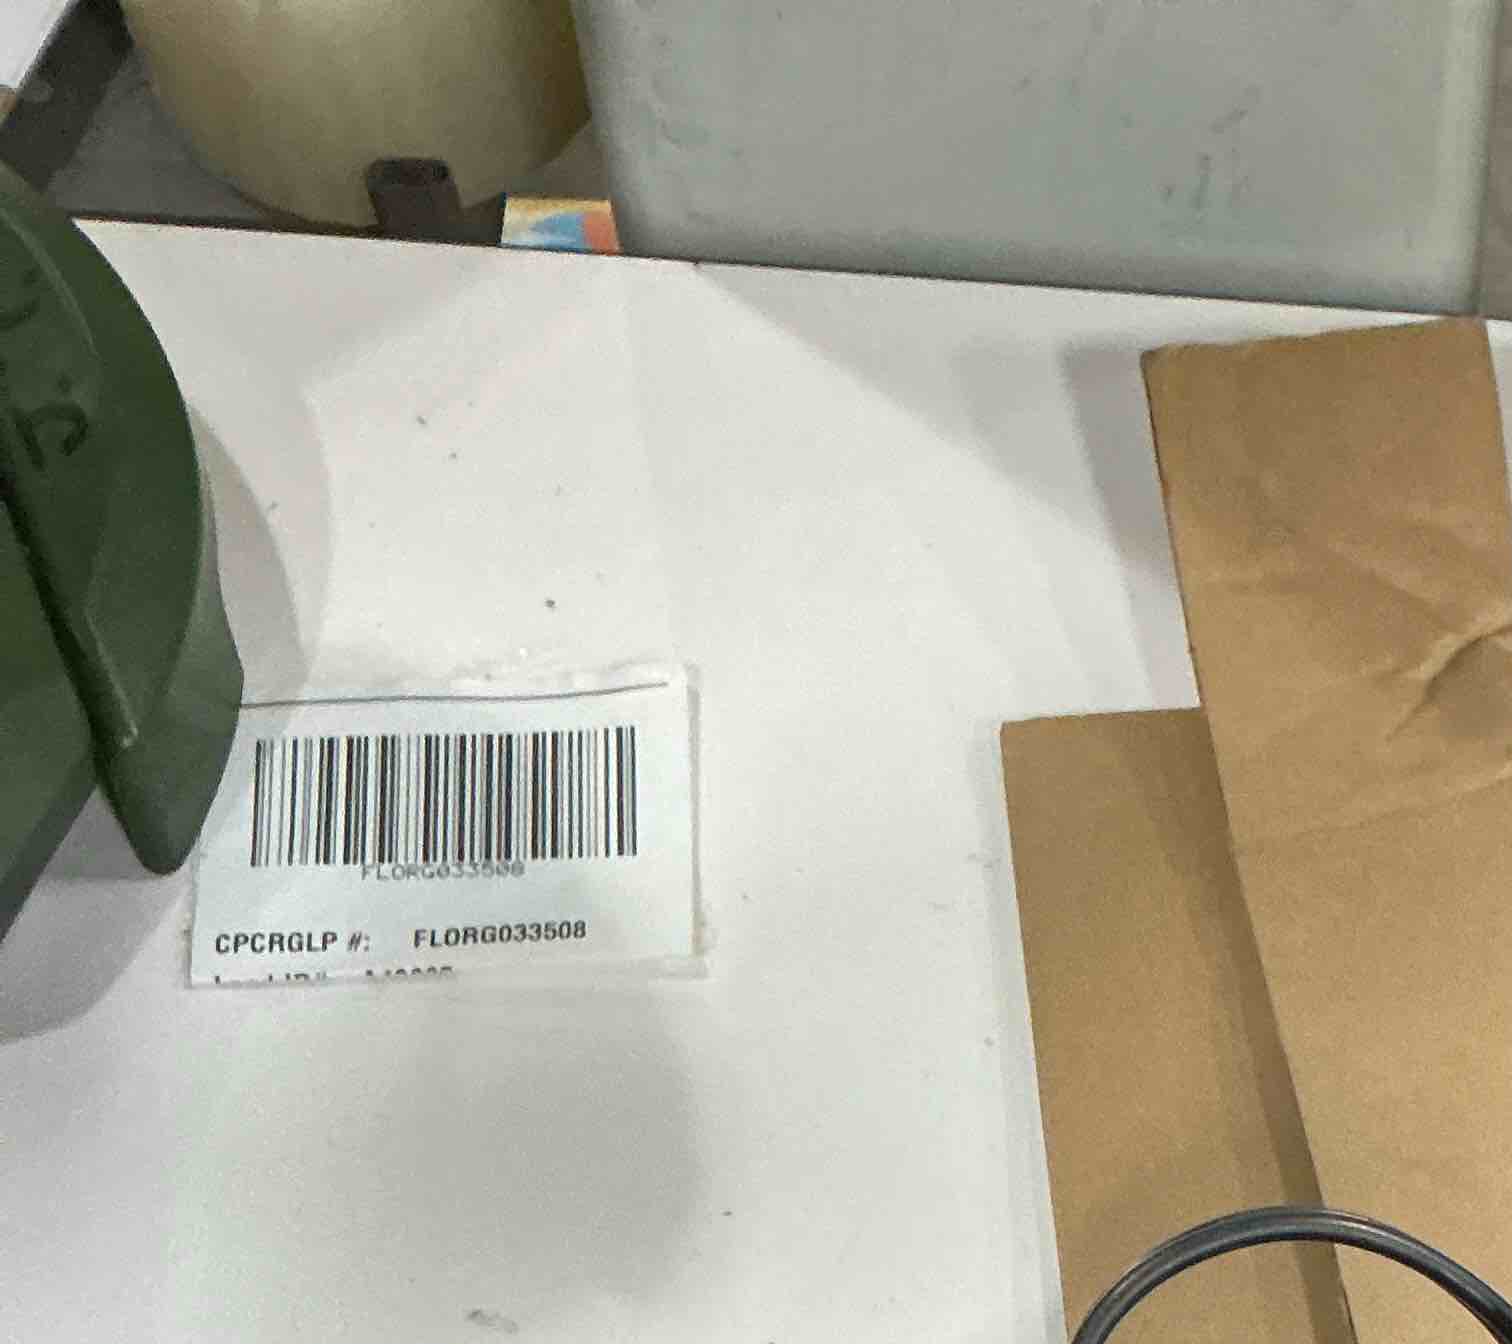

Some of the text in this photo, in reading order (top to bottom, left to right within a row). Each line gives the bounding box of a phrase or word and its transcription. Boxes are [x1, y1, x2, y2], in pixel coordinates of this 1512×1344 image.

[361, 861, 525, 881] FLORG033508
[215, 930, 338, 954] CPCRGLP
[413, 919, 587, 949] FLORG033508
